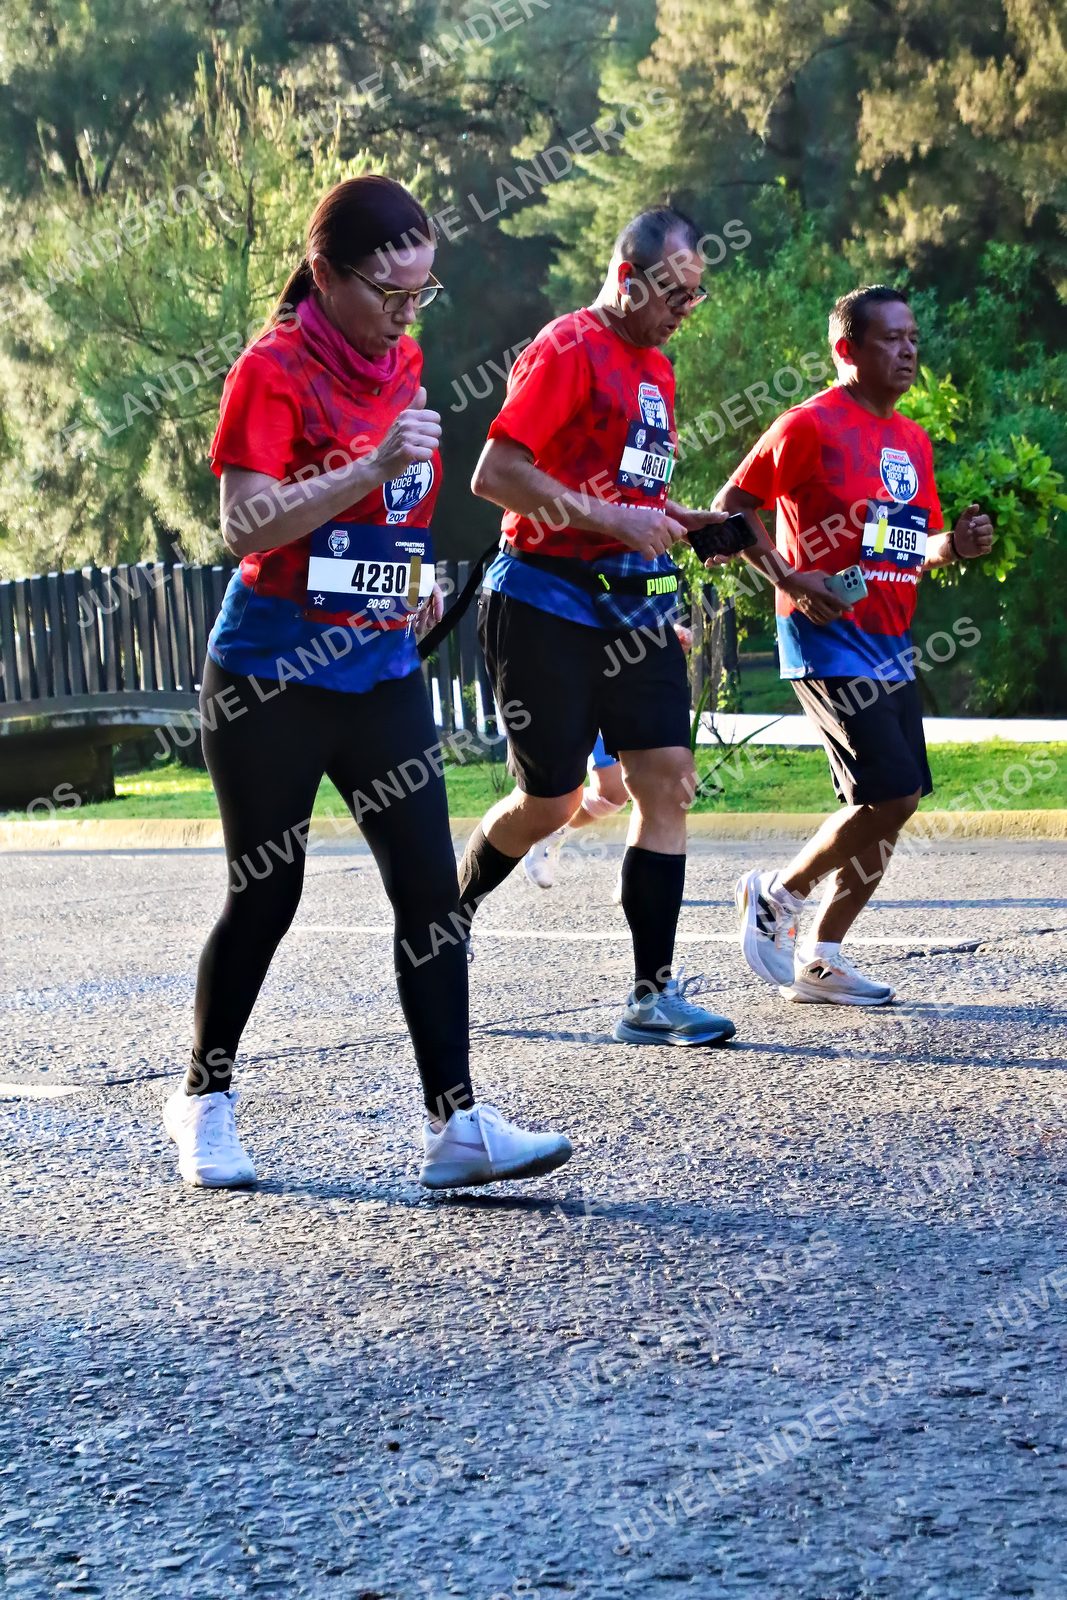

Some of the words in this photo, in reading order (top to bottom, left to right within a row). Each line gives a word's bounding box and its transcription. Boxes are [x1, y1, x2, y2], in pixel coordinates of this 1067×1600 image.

[641, 454, 666, 479] 4860
[888, 529, 917, 551] 4859
[351, 562, 407, 594] 4230
[646, 575, 678, 596] PUMA
